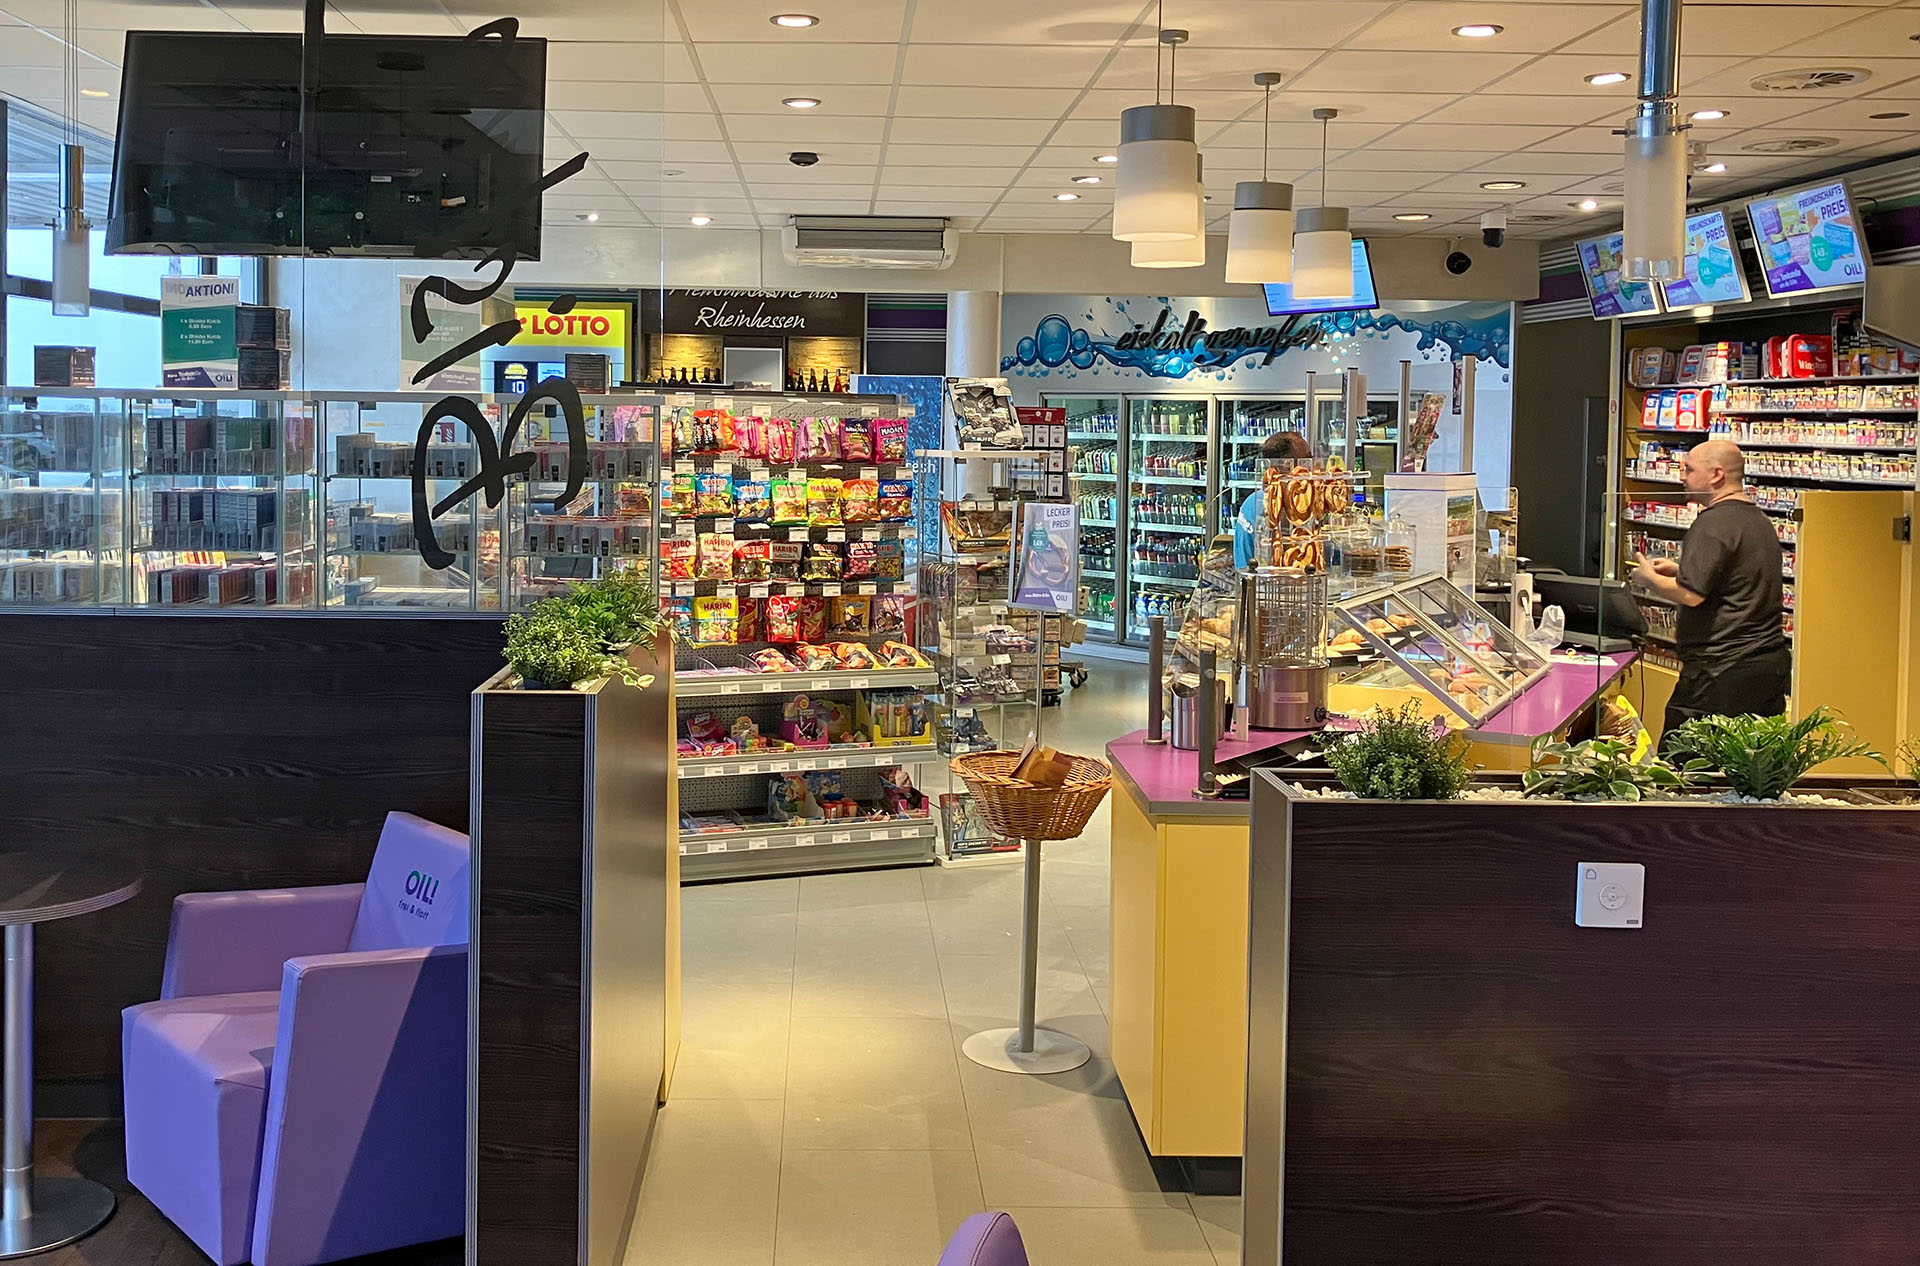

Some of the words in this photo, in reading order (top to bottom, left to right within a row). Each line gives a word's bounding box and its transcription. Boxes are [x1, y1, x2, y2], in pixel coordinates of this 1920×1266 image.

[1820, 198, 1849, 220] PREIS!
[1843, 262, 1863, 276] OIL!
[185, 283, 234, 298] AKTION!
[695, 300, 806, 329] Rheinhessen
[532, 314, 610, 336] LOTTO
[1798, 358, 1827, 370] Winston
[511, 380, 526, 394] 10
[1046, 507, 1071, 518] LECKER
[1051, 519, 1071, 529] PREIS!
[672, 539, 691, 548] RIBO
[703, 538, 731, 547] HARIBO
[772, 545, 798, 553] HARIBO
[703, 602, 732, 611] HARIBO
[405, 870, 440, 905] OIL!
